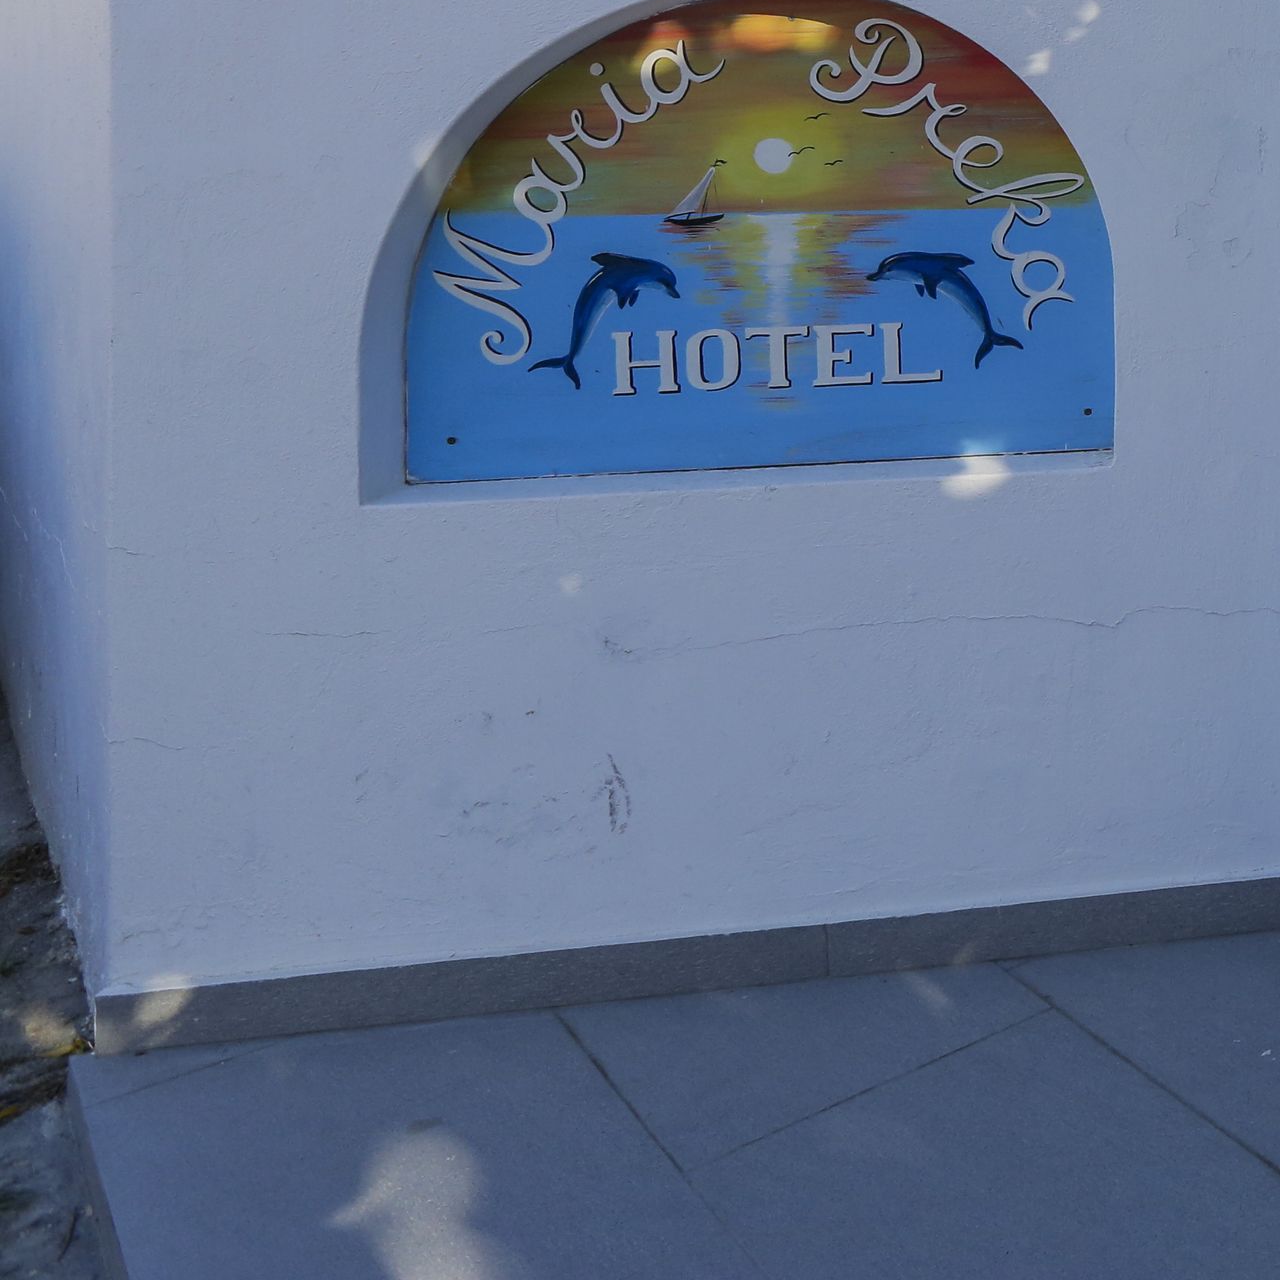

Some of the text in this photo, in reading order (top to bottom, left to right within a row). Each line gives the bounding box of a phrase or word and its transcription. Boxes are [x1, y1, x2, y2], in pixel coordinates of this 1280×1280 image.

[433, 17, 1085, 365] Maria Preka
[610, 323, 942, 395] HOTEL
